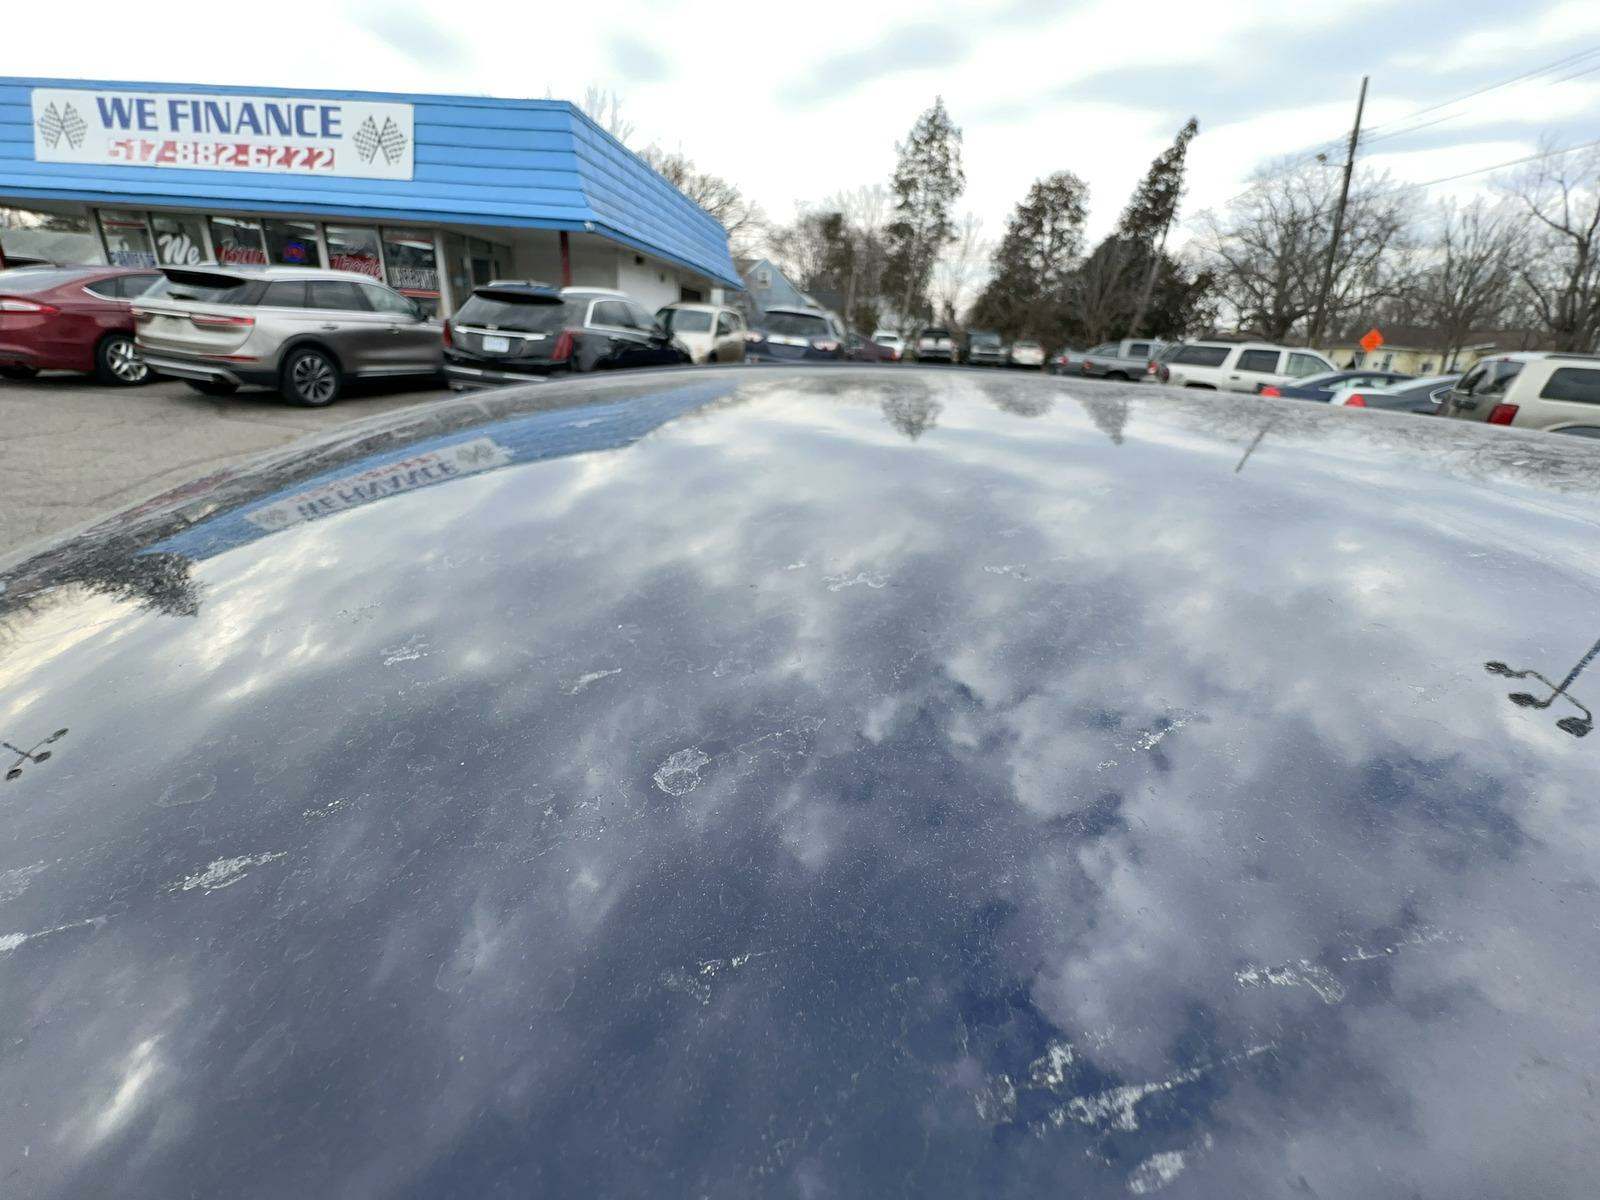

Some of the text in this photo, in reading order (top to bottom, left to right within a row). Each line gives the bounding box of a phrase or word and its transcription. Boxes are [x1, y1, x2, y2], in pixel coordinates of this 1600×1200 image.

[96, 97, 343, 139] WE FINANCE
[108, 139, 336, 170] 517-882-6222
[158, 233, 200, 265] We
